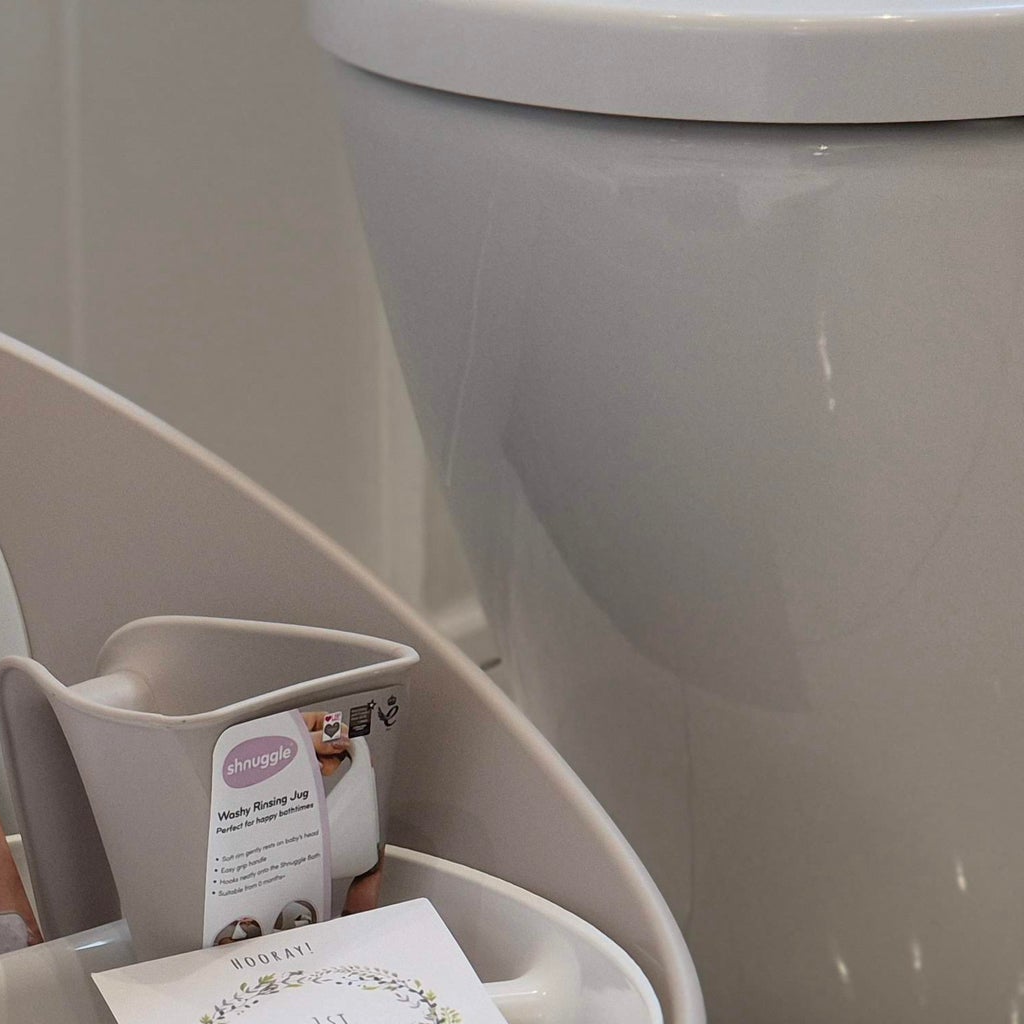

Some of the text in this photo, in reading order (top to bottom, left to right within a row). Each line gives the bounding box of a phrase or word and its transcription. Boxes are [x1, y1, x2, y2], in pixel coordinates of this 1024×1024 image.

[227, 745, 291, 775] shnuggle
[216, 803, 314, 834] Perfect for happy bathtimes
[217, 790, 309, 821] Washy Rinsing Jug
[230, 942, 315, 970] HOORAY!
